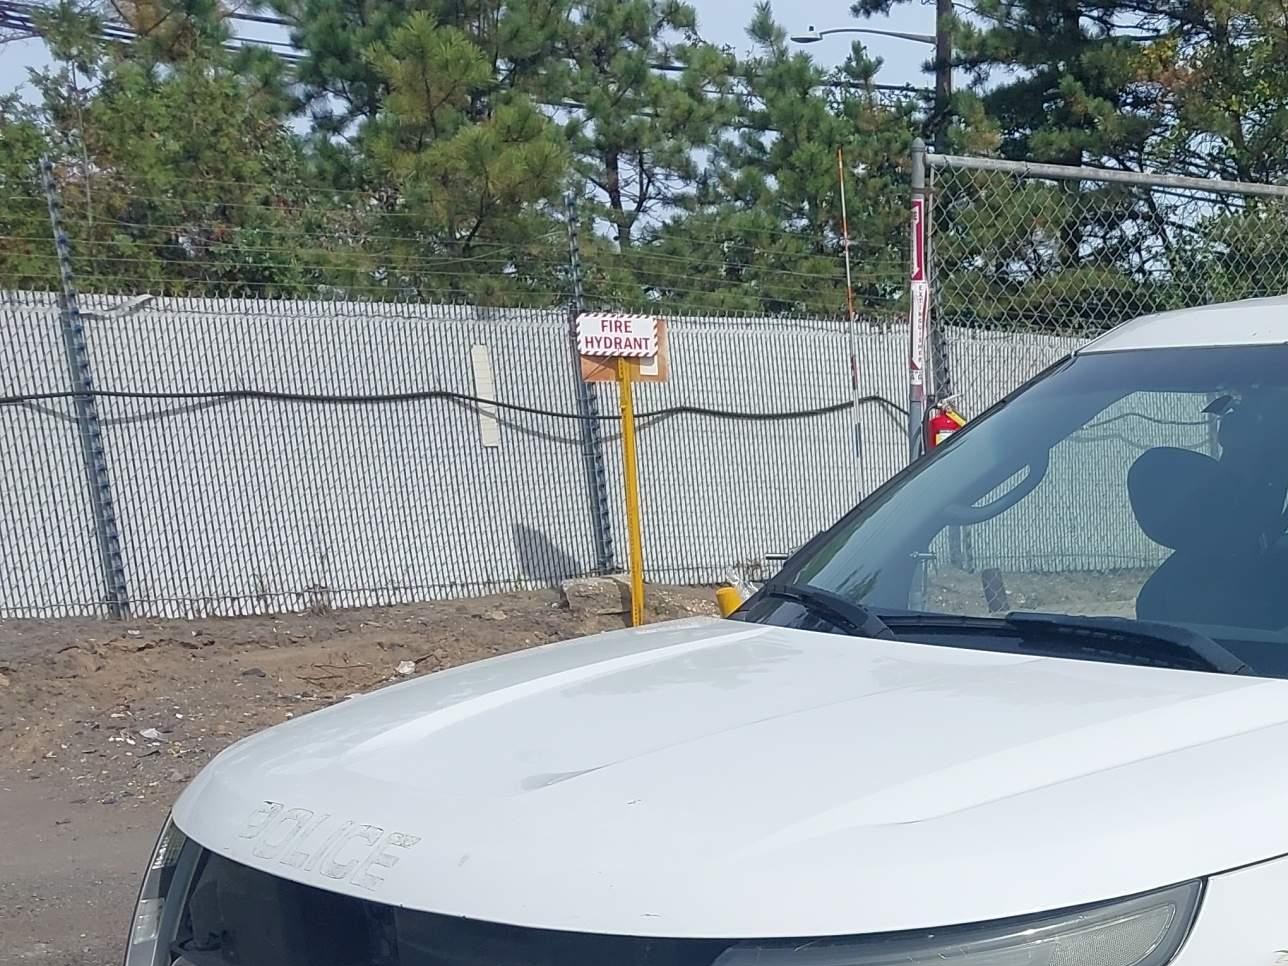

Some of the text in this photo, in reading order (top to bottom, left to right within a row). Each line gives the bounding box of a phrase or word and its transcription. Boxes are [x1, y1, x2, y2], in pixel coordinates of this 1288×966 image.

[601, 319, 632, 333] FIRE
[585, 336, 650, 350] HYDRANT
[232, 800, 422, 892] POLICE
